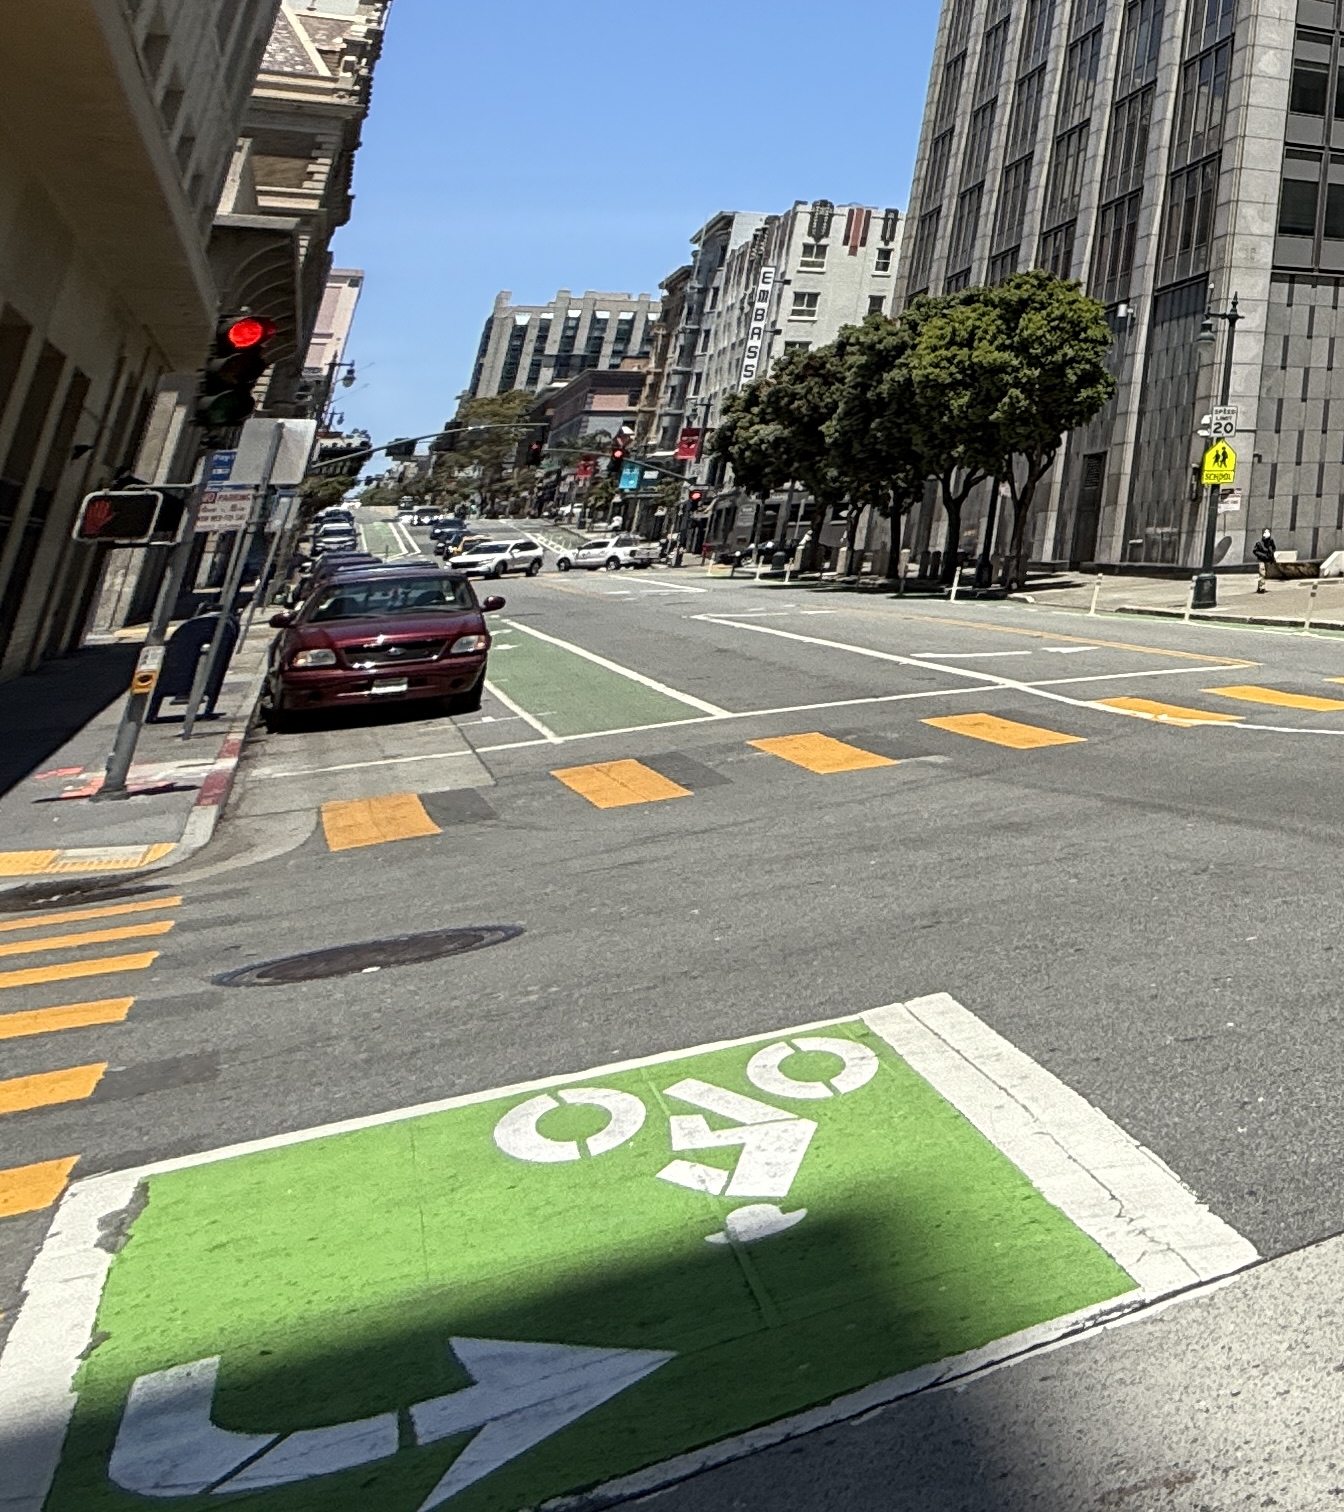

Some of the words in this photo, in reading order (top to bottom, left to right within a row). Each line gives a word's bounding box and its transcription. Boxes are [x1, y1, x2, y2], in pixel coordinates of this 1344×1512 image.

[743, 271, 773, 378] EMBASS
[1213, 422, 1234, 434] 20
[1205, 473, 1231, 481] SCHOOL
